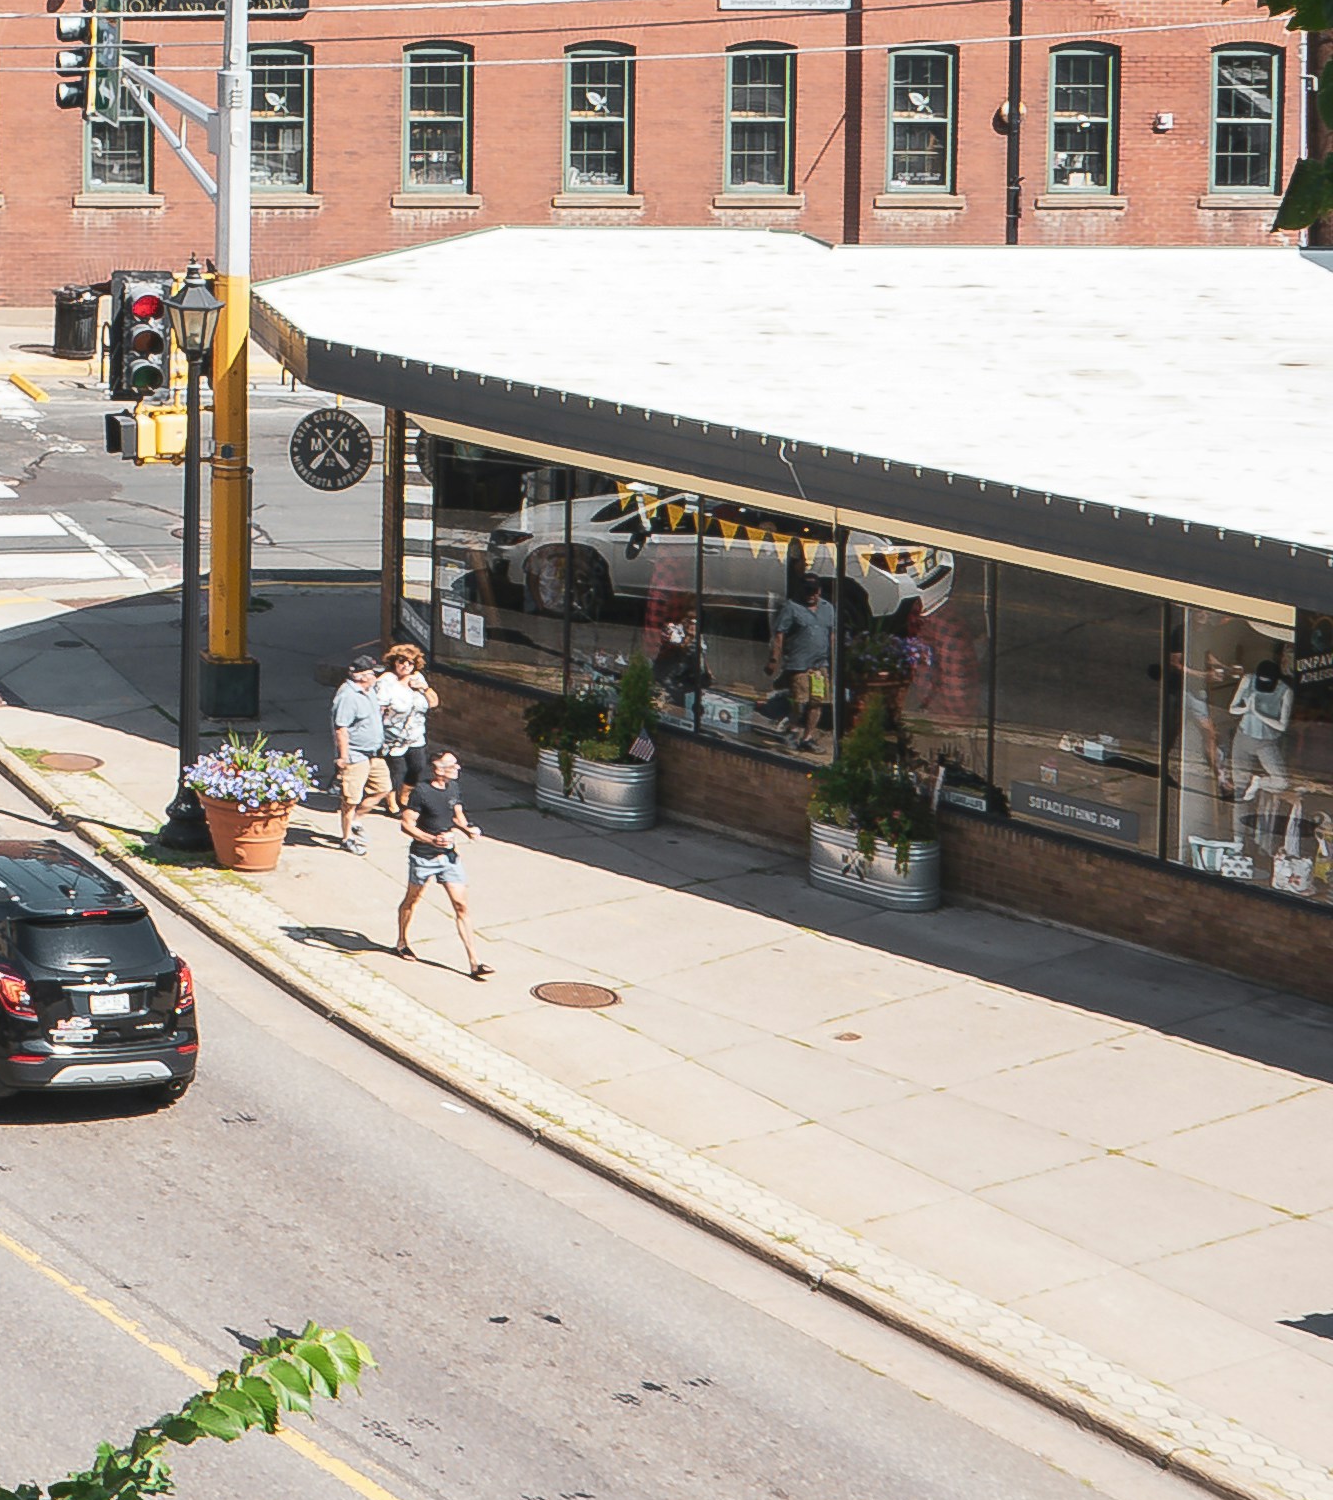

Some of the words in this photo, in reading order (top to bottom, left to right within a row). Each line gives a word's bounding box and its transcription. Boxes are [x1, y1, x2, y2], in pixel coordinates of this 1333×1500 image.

[294, 421, 312, 443] SOTA
[313, 412, 360, 430] CLOTHING
[310, 438, 322, 451] M
[339, 438, 349, 451] N
[293, 455, 332, 487] MINNESOTA
[337, 458, 368, 487] APPAREL
[1029, 795, 1121, 830] SOTACLOTHING.COM
